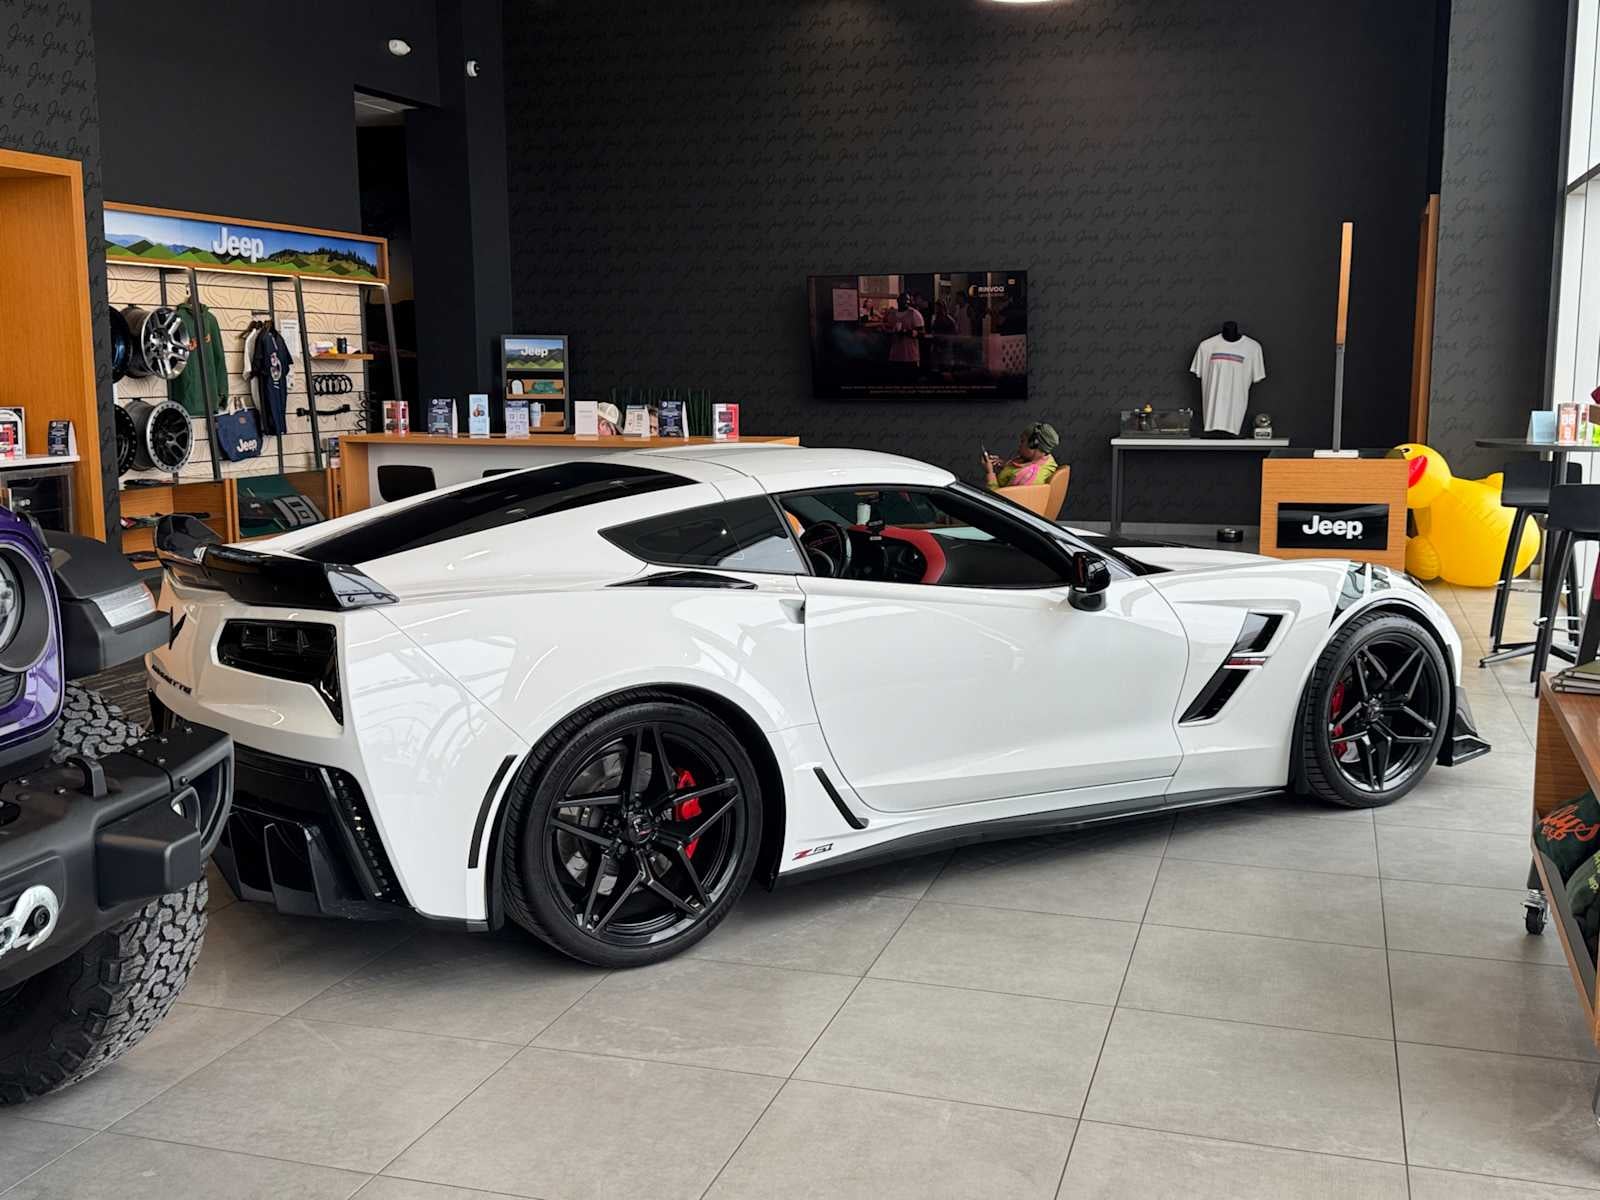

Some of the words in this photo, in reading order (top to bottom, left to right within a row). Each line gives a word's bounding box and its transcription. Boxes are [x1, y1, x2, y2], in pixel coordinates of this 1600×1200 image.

[213, 227, 263, 263] Jeep
[521, 346, 548, 358] Jeep
[237, 439, 257, 452] Jeep
[1302, 515, 1362, 539] Jeep
[792, 843, 834, 861] Z51
